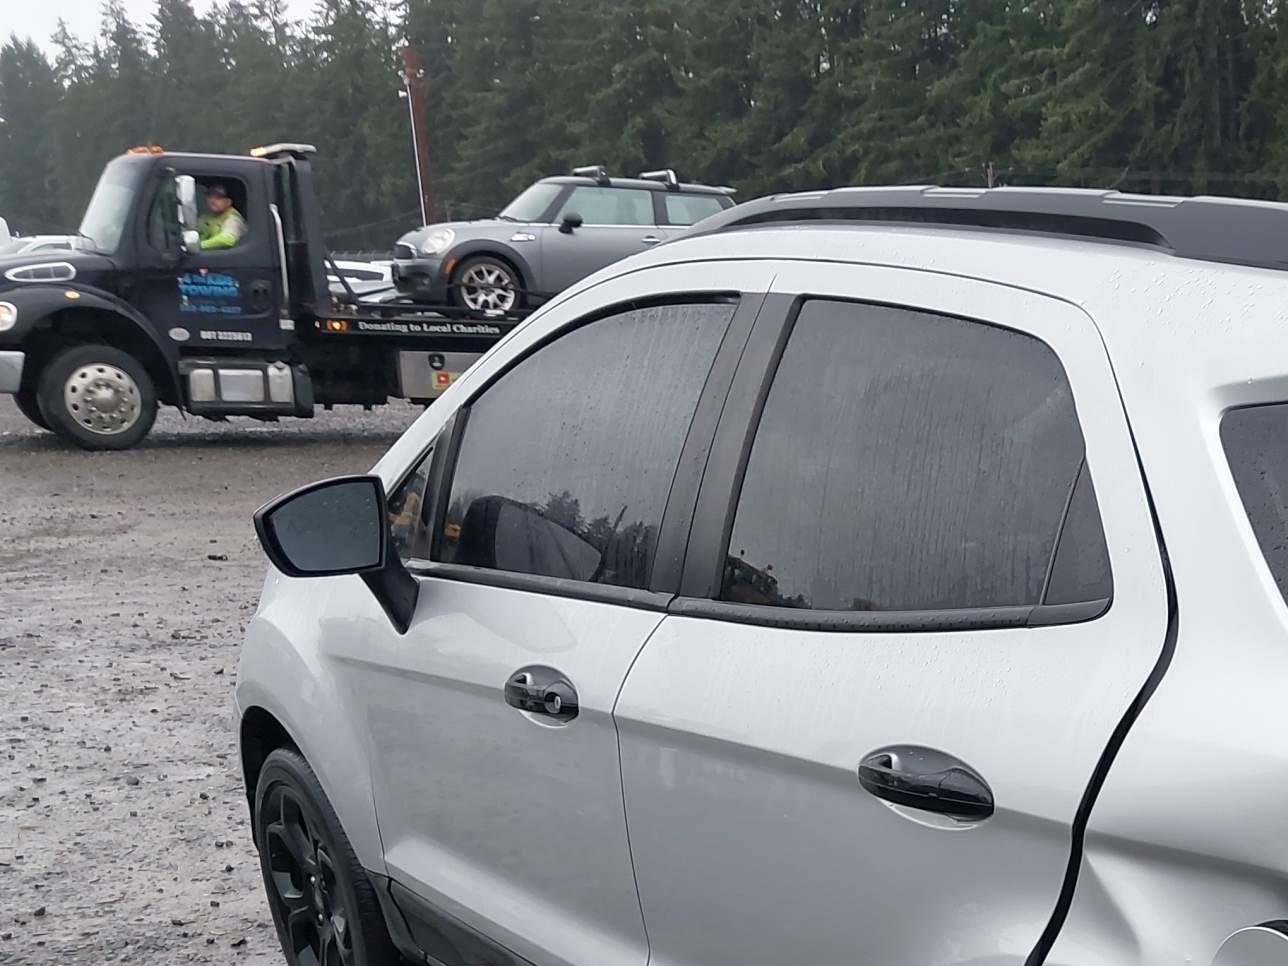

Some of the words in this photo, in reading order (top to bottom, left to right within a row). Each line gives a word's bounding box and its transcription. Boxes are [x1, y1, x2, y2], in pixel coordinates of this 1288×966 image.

[178, 285, 239, 297] TOWING
[358, 320, 408, 333] Donating
[409, 323, 421, 332] to
[423, 323, 451, 333] Local
[452, 323, 500, 334] Charities
